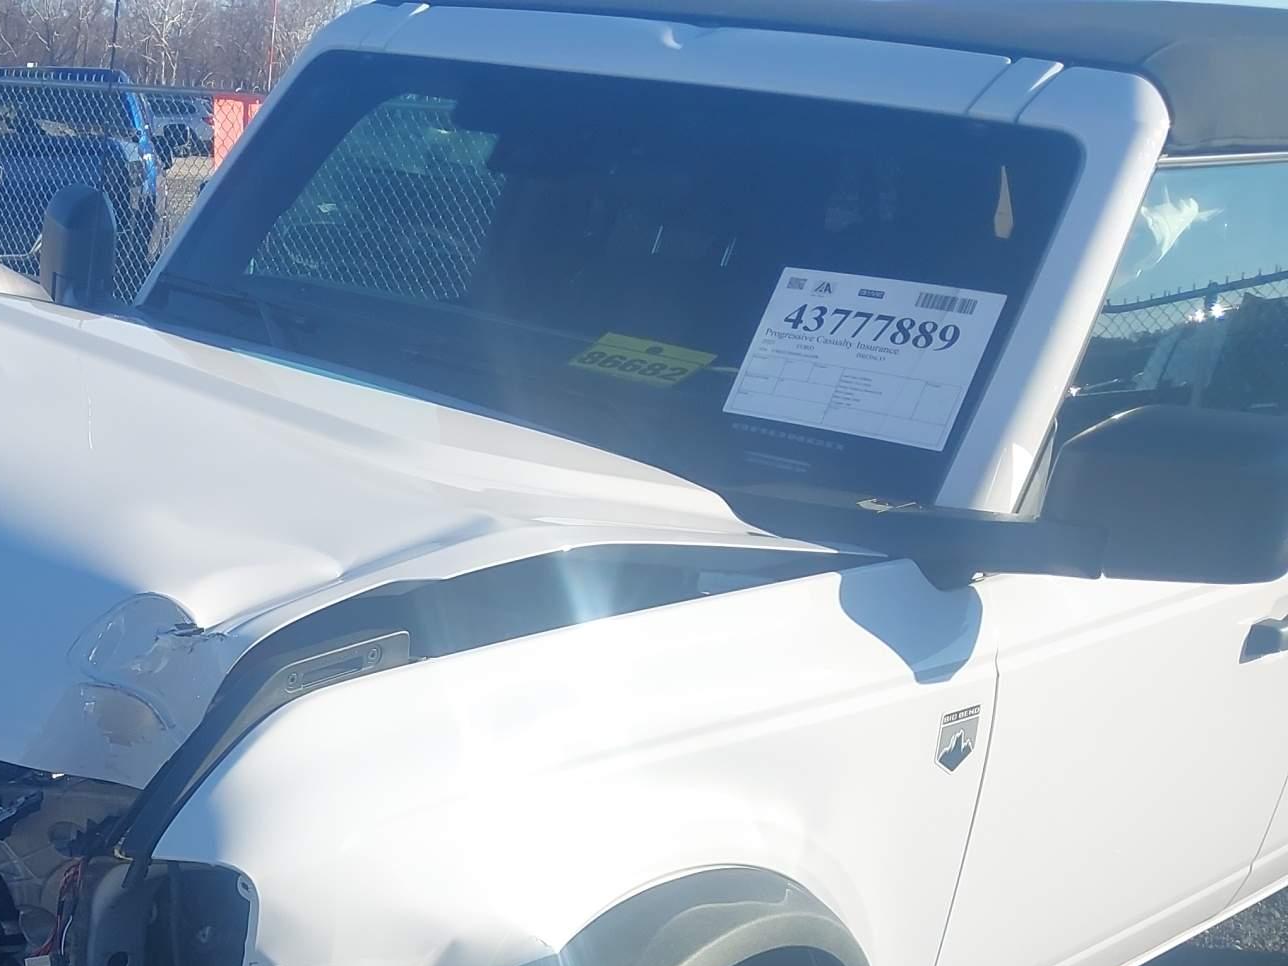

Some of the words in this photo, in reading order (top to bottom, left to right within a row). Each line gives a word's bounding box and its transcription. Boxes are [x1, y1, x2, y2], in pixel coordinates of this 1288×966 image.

[765, 328, 814, 342] Progressive
[816, 335, 853, 349] Casualty
[856, 341, 901, 355] Insurance
[784, 304, 961, 350] 43777889
[578, 351, 689, 381] 86682
